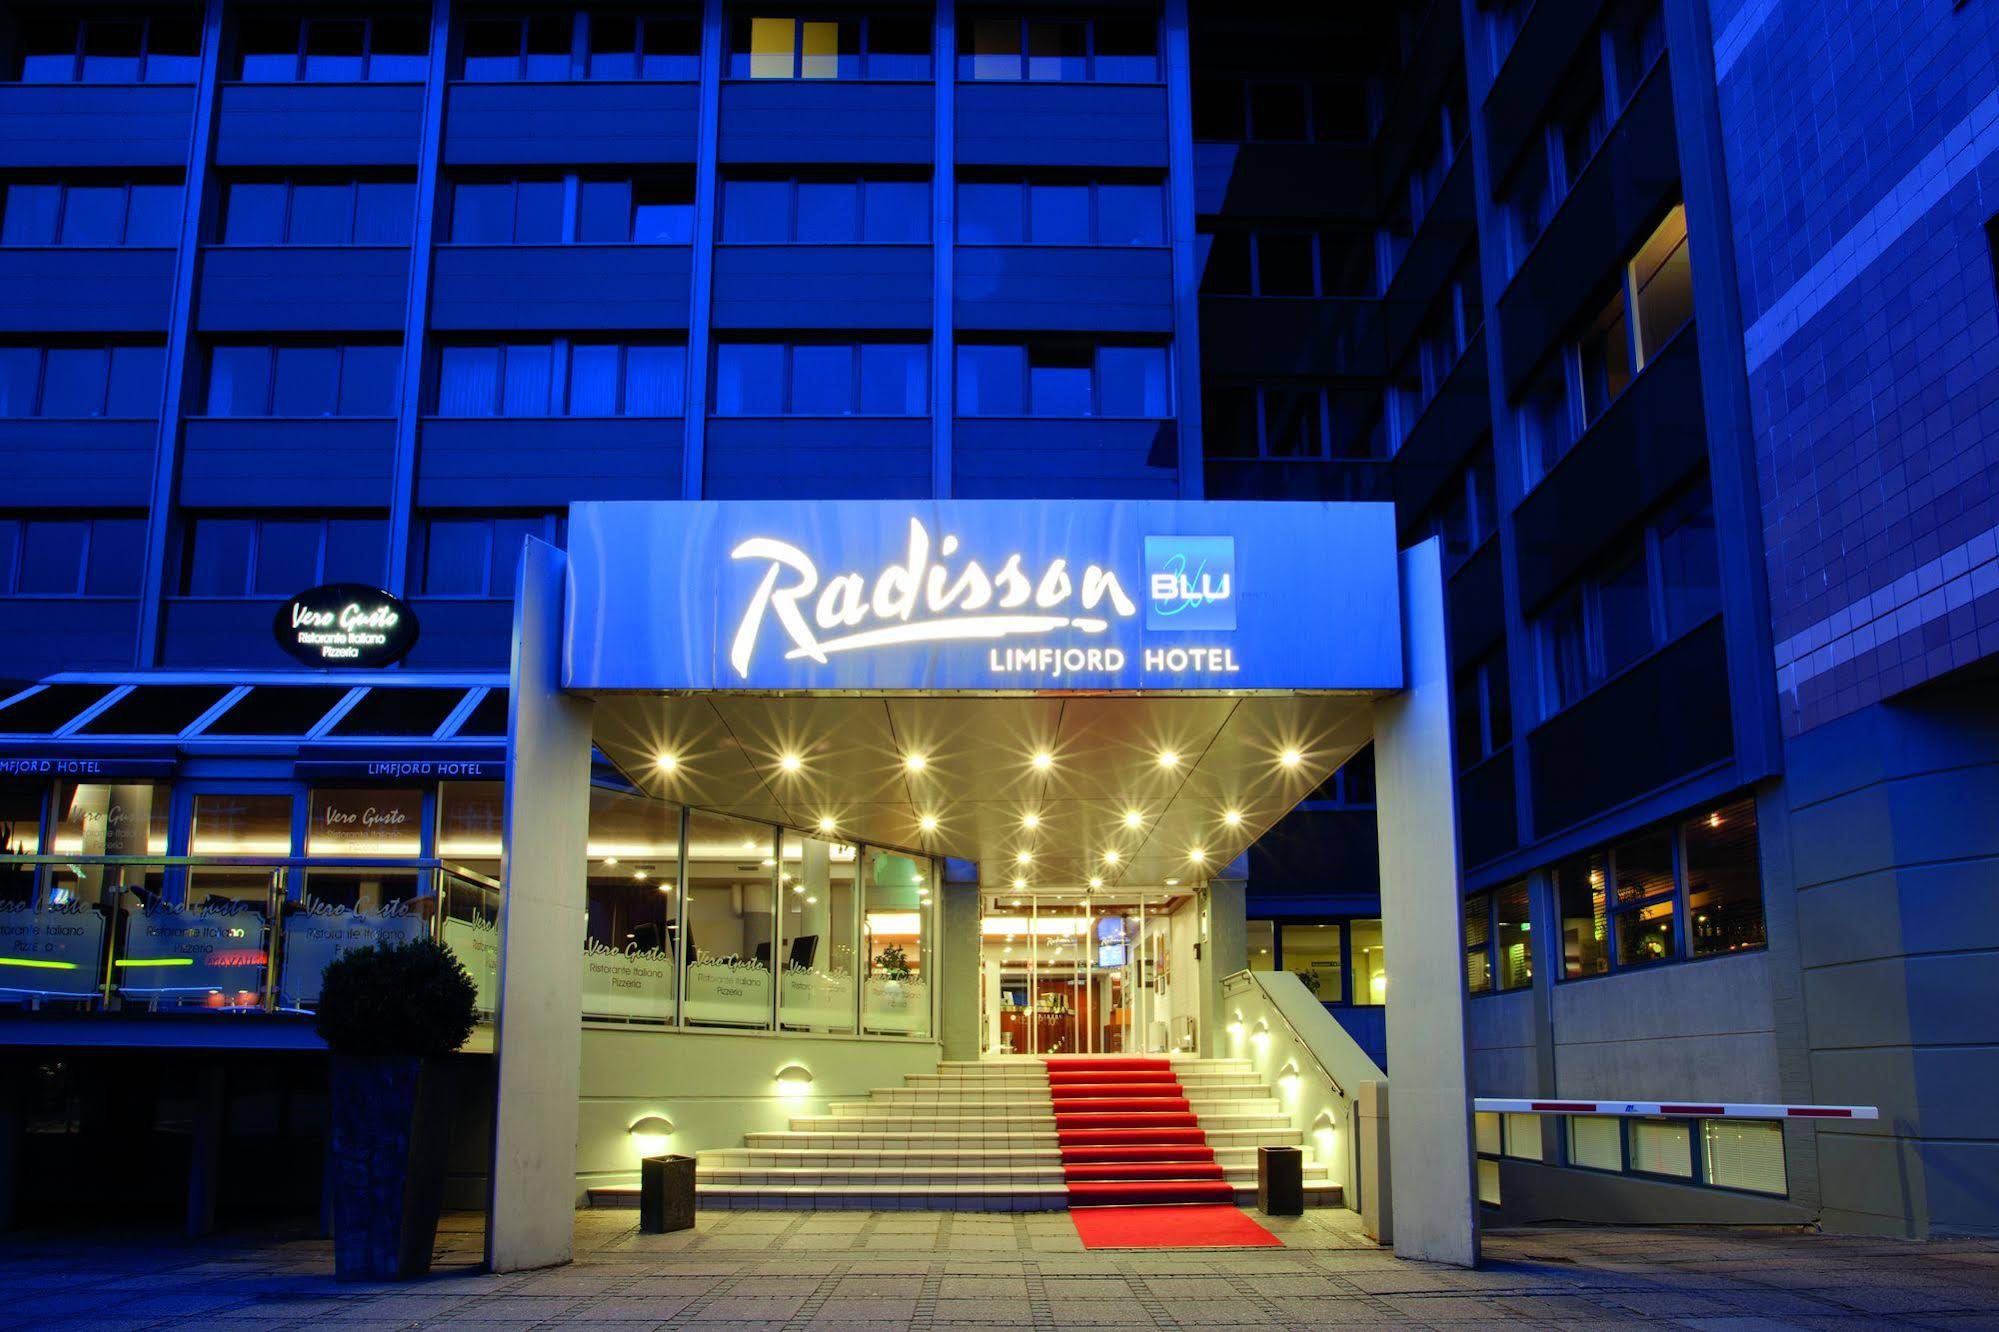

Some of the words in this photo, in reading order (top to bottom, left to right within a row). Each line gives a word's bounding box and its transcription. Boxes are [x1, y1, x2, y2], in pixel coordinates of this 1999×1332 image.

[731, 516, 1136, 678] Radisson
[1151, 573, 1230, 600] BLU
[292, 602, 335, 628] Vero
[340, 603, 398, 632] Gusto
[298, 632, 347, 643] Ristorante
[348, 632, 385, 644] Italiano
[322, 646, 359, 657] Pizzeria
[990, 648, 1124, 677] LIMFJORD
[1145, 648, 1239, 672] HOTEL
[58, 762, 101, 773] HOTEL
[368, 764, 431, 777] LIMFJORD
[438, 764, 482, 774] HOTEL
[326, 806, 357, 825] Vero
[362, 807, 406, 828] Gusto
[305, 893, 346, 918] Vero
[588, 936, 620, 956] Vero
[625, 941, 666, 963] Gusto
[589, 963, 631, 976] Ristorante
[633, 967, 663, 978] Italiano
[697, 950, 724, 967] Vero
[728, 953, 764, 973] Gusto
[789, 958, 813, 976] Vero
[611, 977, 642, 988] Pizzeria
[717, 986, 743, 997] Pizzeria
